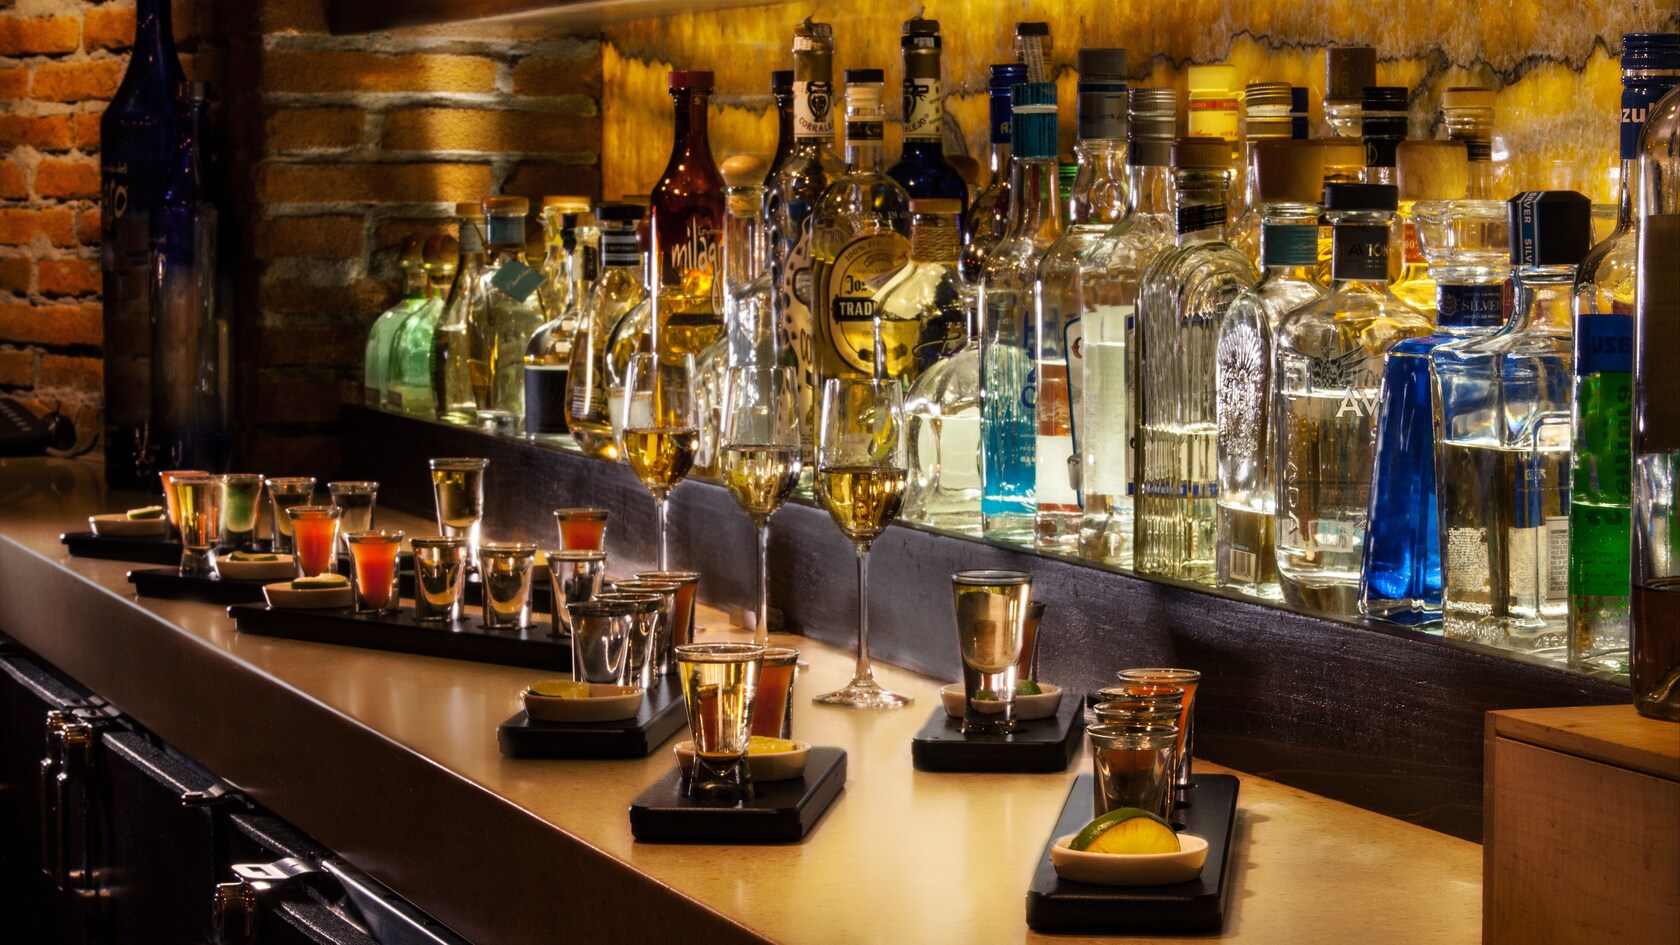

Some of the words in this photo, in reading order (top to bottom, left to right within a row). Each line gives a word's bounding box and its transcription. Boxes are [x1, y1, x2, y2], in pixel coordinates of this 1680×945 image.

[798, 116, 834, 133] CORRALE
[903, 117, 927, 133] ALEJO
[1523, 192, 1537, 223] SILVER
